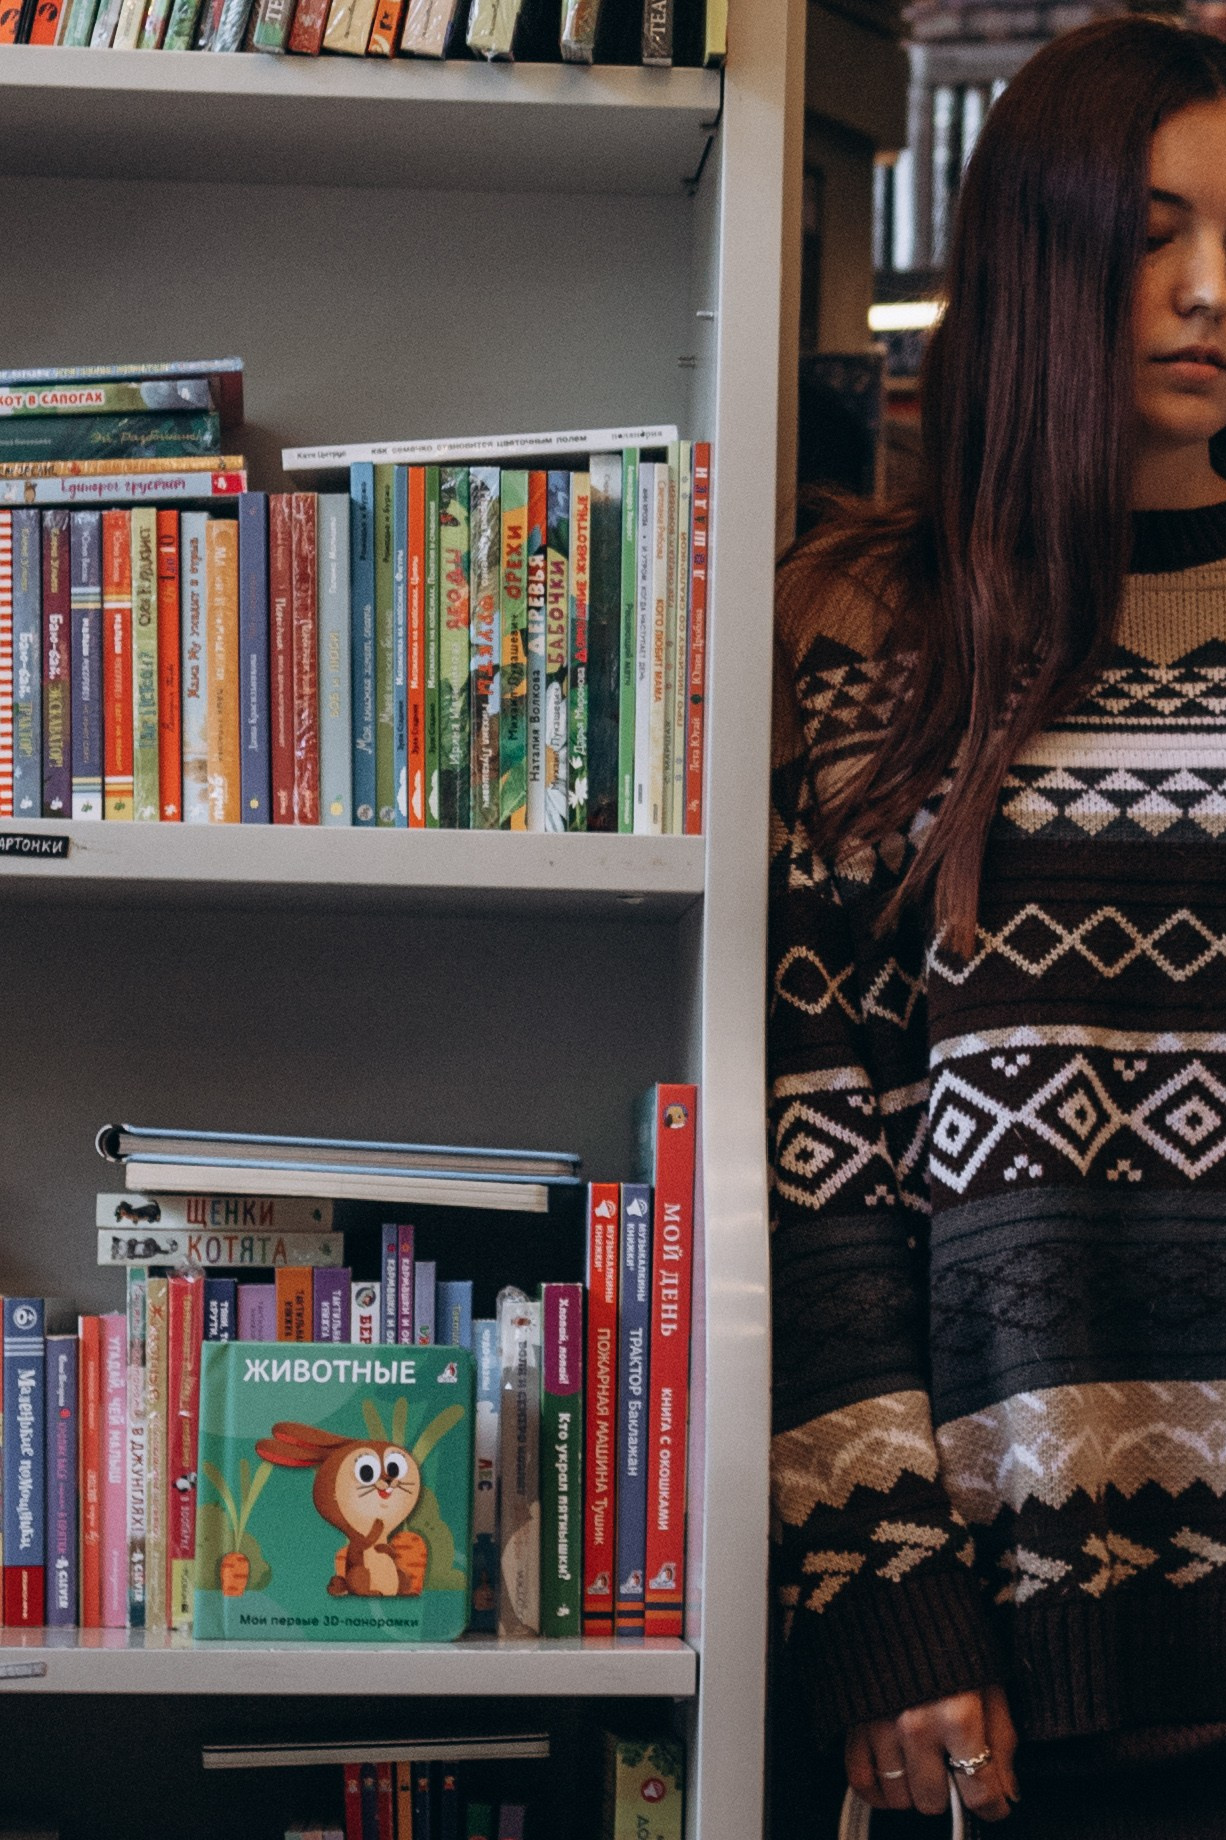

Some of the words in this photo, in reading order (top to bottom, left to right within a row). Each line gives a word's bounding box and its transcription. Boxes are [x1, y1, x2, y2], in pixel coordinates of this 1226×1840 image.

[26, 394, 36, 406] В
[41, 392, 103, 405] САПОГАХ
[503, 525, 523, 600] ОРЕХИ
[574, 495, 588, 574] ЖИВОТНЫЕ
[444, 548, 463, 630] ЯГОДЫ
[527, 554, 546, 656] ДЕРЕВЬЯ
[547, 560, 566, 664] БАБОЧКИ
[654, 599, 664, 627] КОГО
[47, 614, 63, 680] Баю-бай,
[476, 594, 498, 695] ФРУКТЫ
[574, 579, 588, 663] ДОМАШНИЕ
[654, 630, 664, 668] ЛЮБИТ
[507, 614, 520, 687] Лукашевич
[530, 670, 542, 723] Волкова
[574, 667, 588, 720] Миронова
[654, 671, 664, 703] МАМА
[48, 683, 63, 767] ЭКСКАВАТОР!
[507, 693, 520, 741] Михаил
[574, 722, 588, 755] Дарья
[530, 727, 542, 783] Наталия
[186, 1199, 275, 1228] ЩЕНКИ
[662, 1202, 683, 1261] МОЙ
[187, 1234, 288, 1265] КОТЯТА
[400, 1258, 411, 1315] КАРМАШКИ
[658, 1269, 680, 1337] ДЕНЬ
[107, 1336, 122, 1394] УГАДАЙ,
[243, 1358, 417, 1385] ЖИВОТНЫЕ
[558, 1346, 569, 1385] лопай!
[594, 1327, 610, 1416] ПОЖАРНАЯ
[627, 1327, 642, 1395] ТРАКТОР
[17, 1368, 36, 1456] Маленькие
[107, 1397, 122, 1427] ЧЕЙ
[557, 1413, 571, 1440] Кто
[626, 1400, 642, 1477] Баклажан
[659, 1387, 672, 1433] КНИГА
[107, 1430, 122, 1484] МАЛЫШ
[554, 1444, 569, 1491] украл
[594, 1420, 610, 1494] МАШИНА
[659, 1436, 672, 1445] С
[130, 1439, 145, 1533] ДЖУНГЛЯХ!
[477, 1459, 493, 1490] ЛЕС
[657, 1449, 671, 1531] ОКОШКАМИ
[15, 1459, 35, 1549] помощники
[593, 1497, 608, 1545] Тушик
[557, 1495, 571, 1581] пятнышки?
[239, 1614, 268, 1626] Мои
[271, 1616, 320, 1627] первые
[323, 1615, 419, 1628] 3D-панорамки
